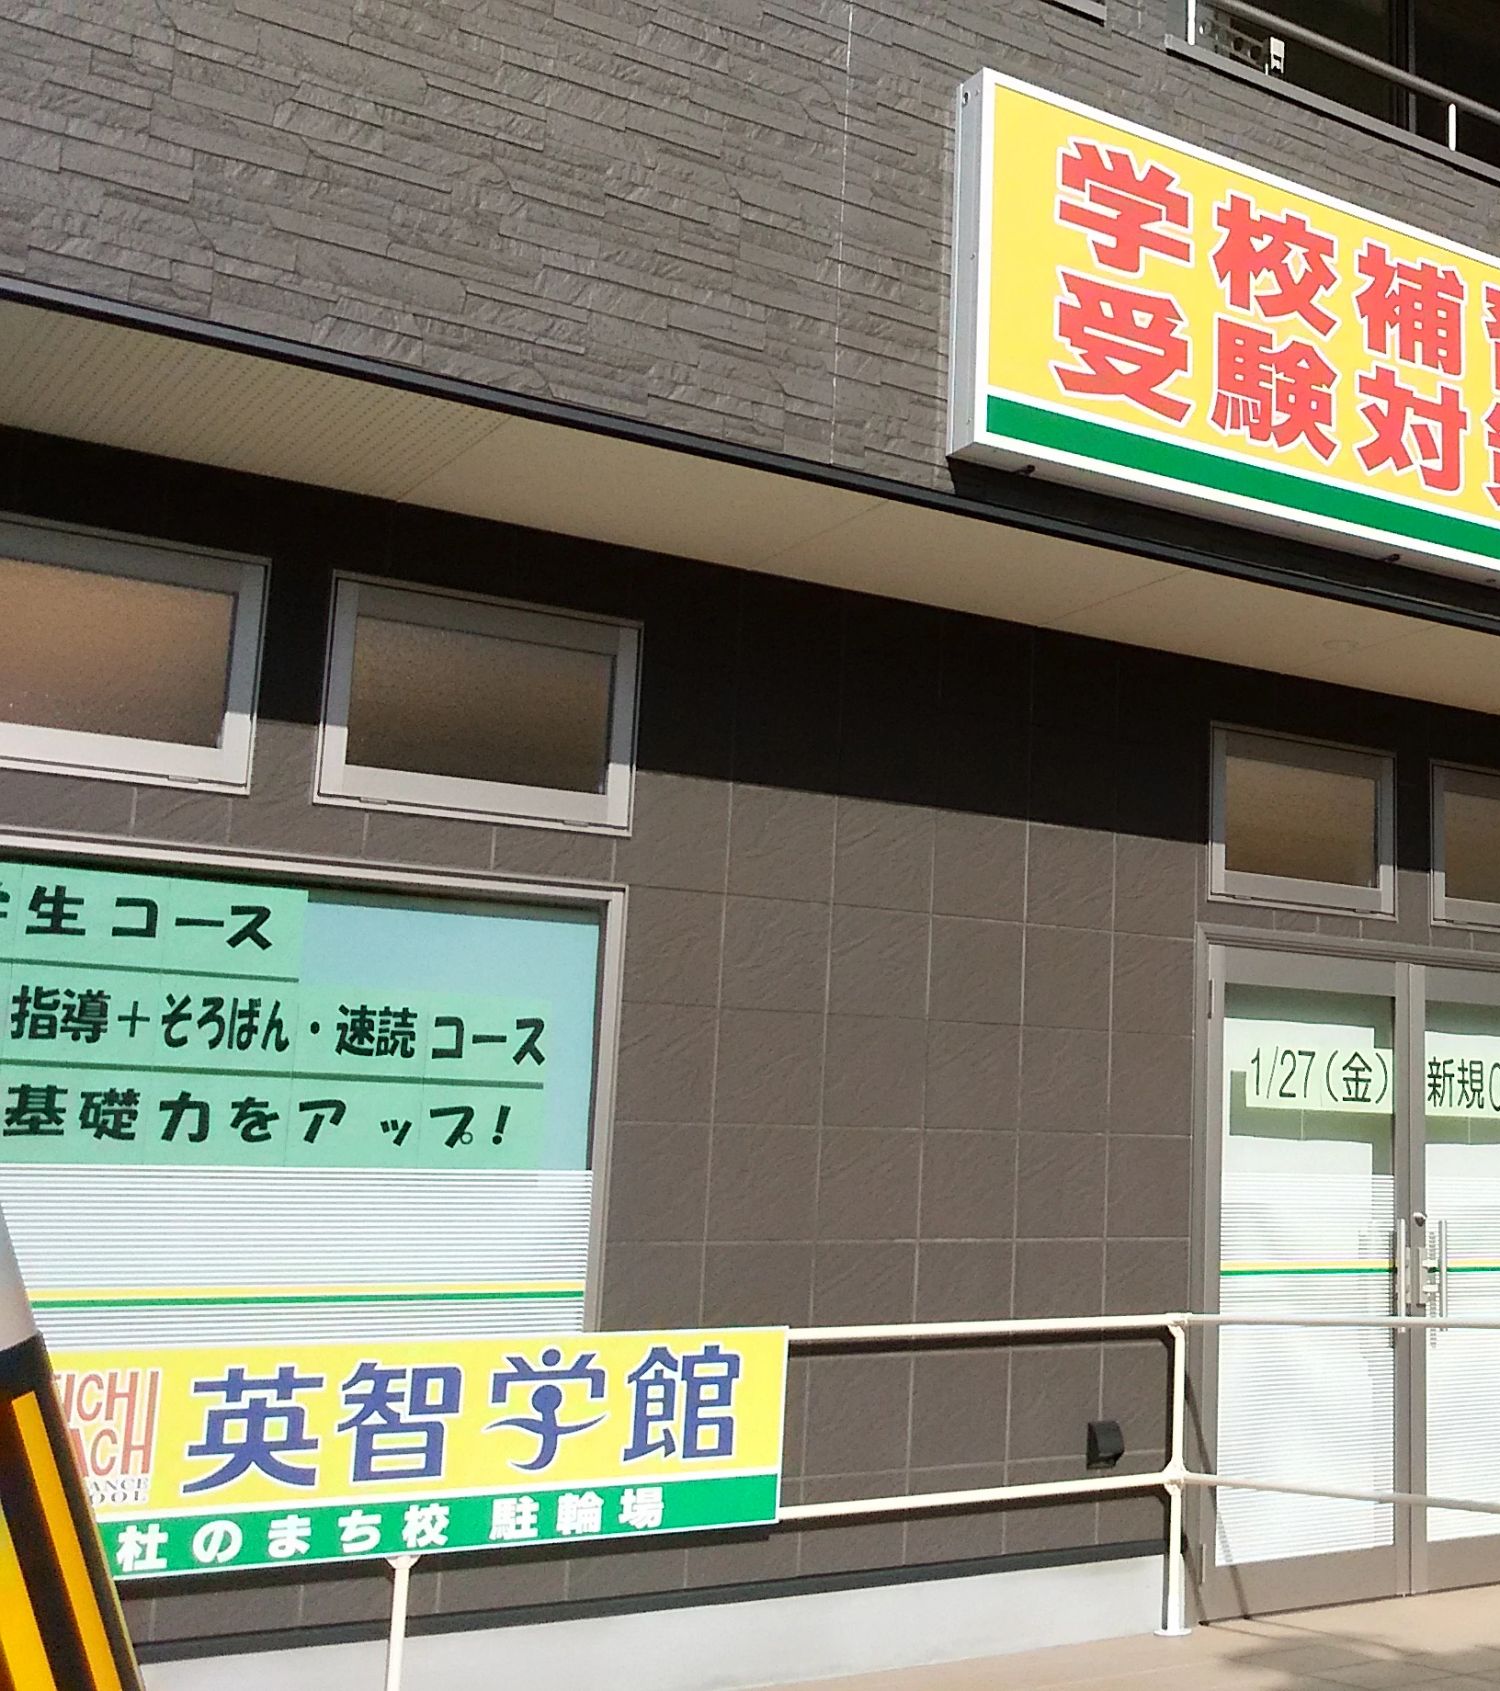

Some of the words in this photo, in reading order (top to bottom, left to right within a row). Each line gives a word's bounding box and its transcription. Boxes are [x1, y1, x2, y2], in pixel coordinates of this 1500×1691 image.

[0, 883, 273, 951] 生コース
[182, 1343, 741, 1495] 英智学館
[116, 1503, 449, 1574] 杜のまち校
[489, 1486, 665, 1542] 駐輪場
